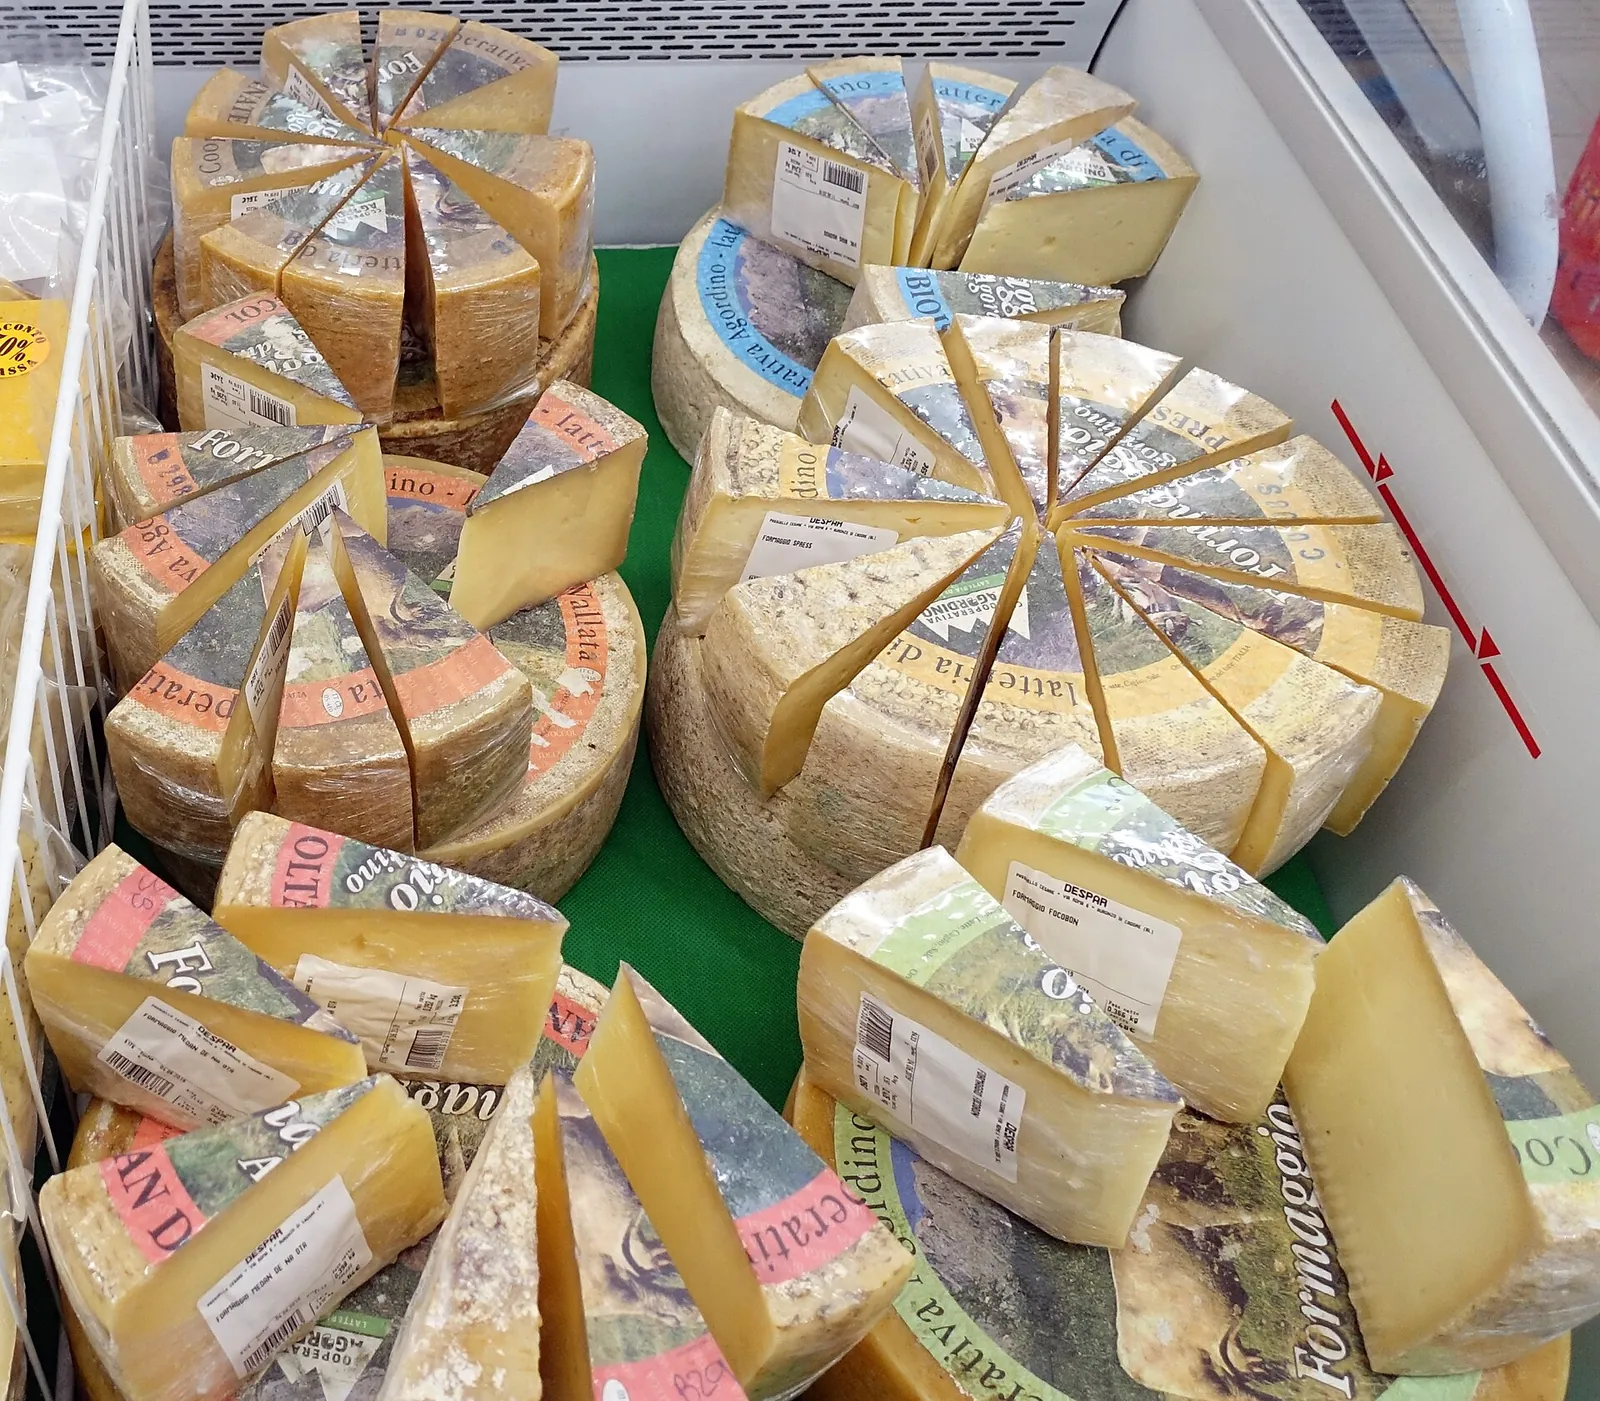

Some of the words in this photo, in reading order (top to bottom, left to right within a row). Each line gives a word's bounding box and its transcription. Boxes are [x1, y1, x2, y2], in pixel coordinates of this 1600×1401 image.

[705, 264, 747, 340] Agordino
[1012, 889, 1047, 913] FORMAGGIO
[1047, 908, 1080, 927] FOCOBON
[1062, 883, 1110, 908] DESPAR
[244, 1227, 284, 1265] DESPAR
[248, 1272, 275, 1295] MEDAN
